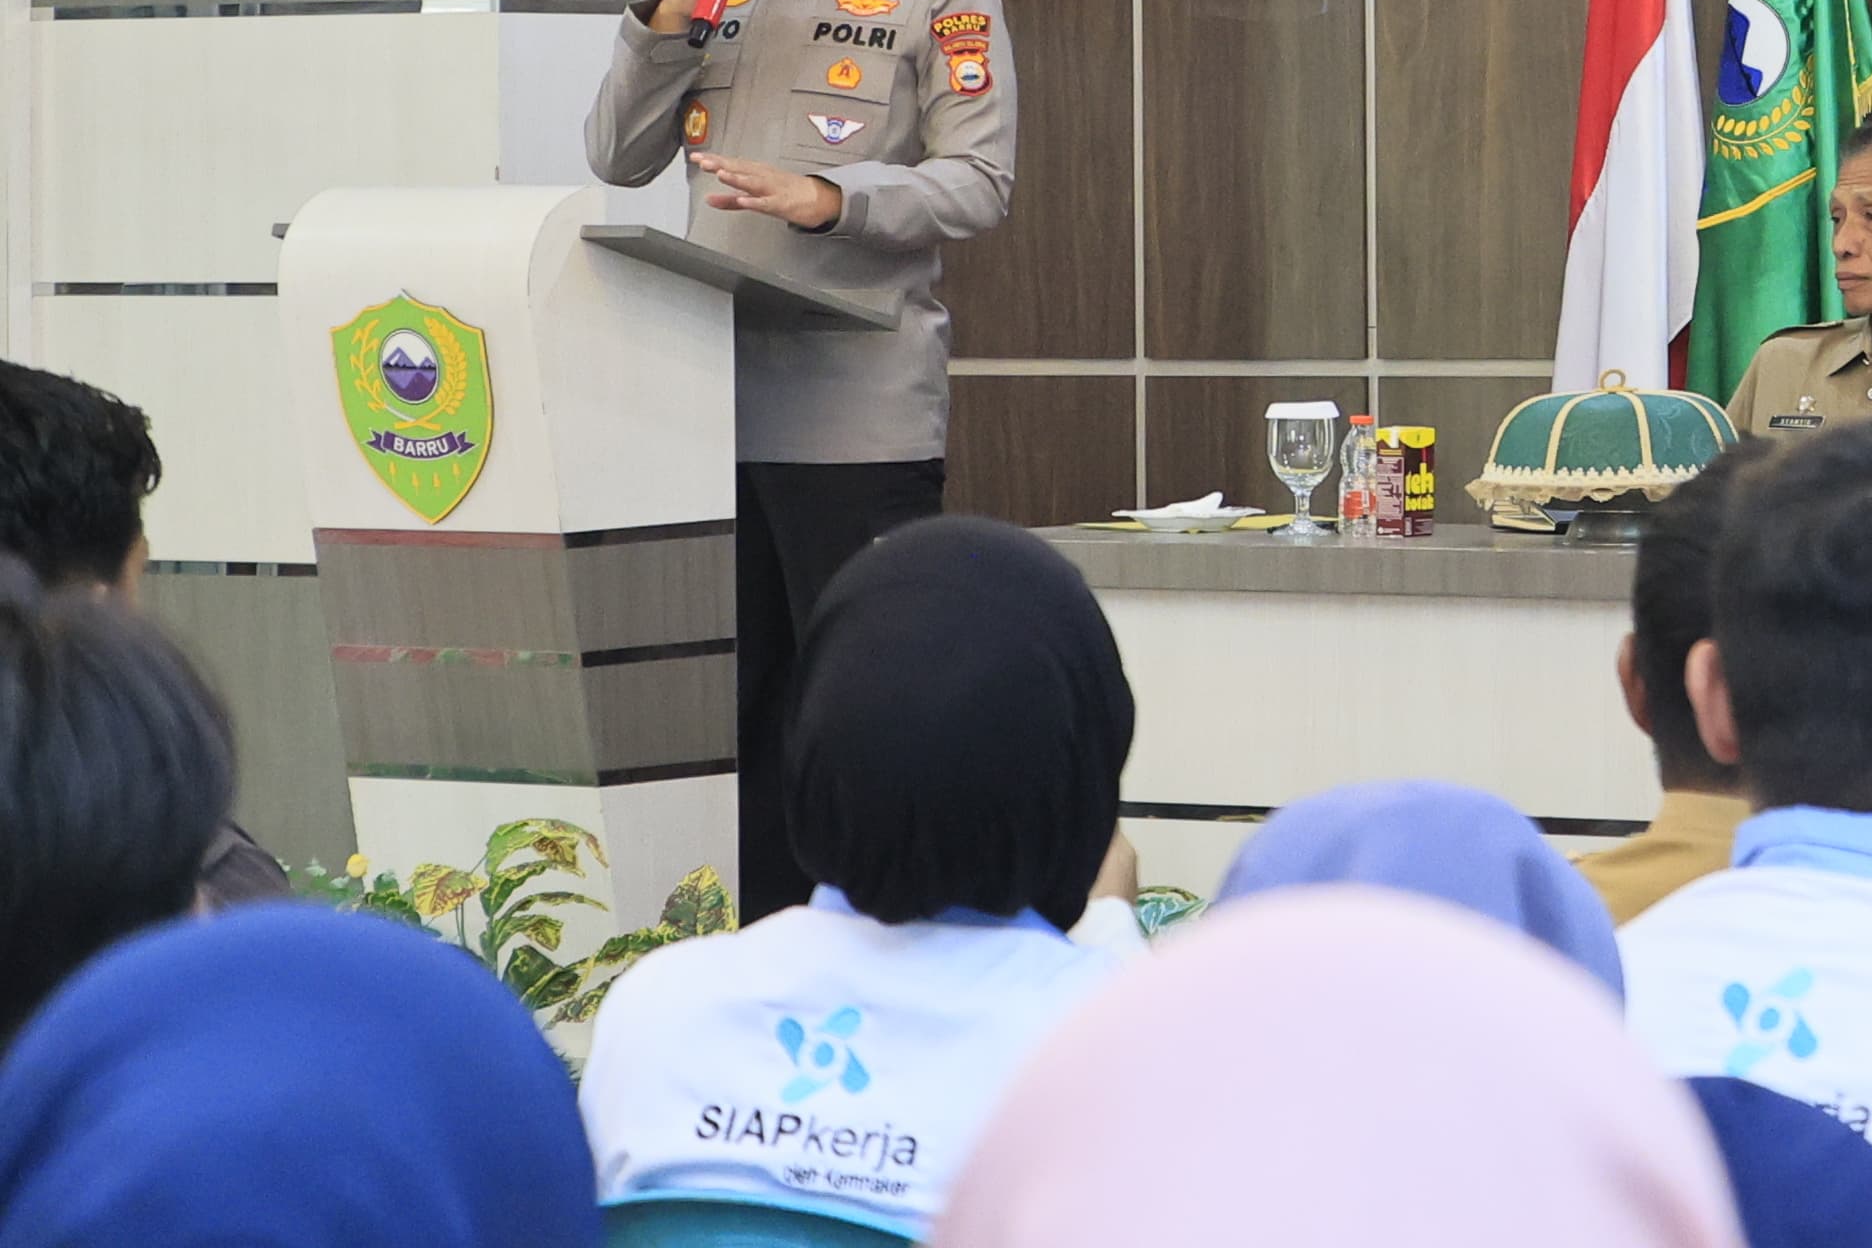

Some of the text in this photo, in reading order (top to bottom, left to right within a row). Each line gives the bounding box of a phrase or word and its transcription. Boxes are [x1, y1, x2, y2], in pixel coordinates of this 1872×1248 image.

[813, 22, 897, 50] POLRI
[933, 15, 987, 33] POLRES
[393, 437, 449, 457] BARRU
[696, 1104, 918, 1173] SIAPkerja
